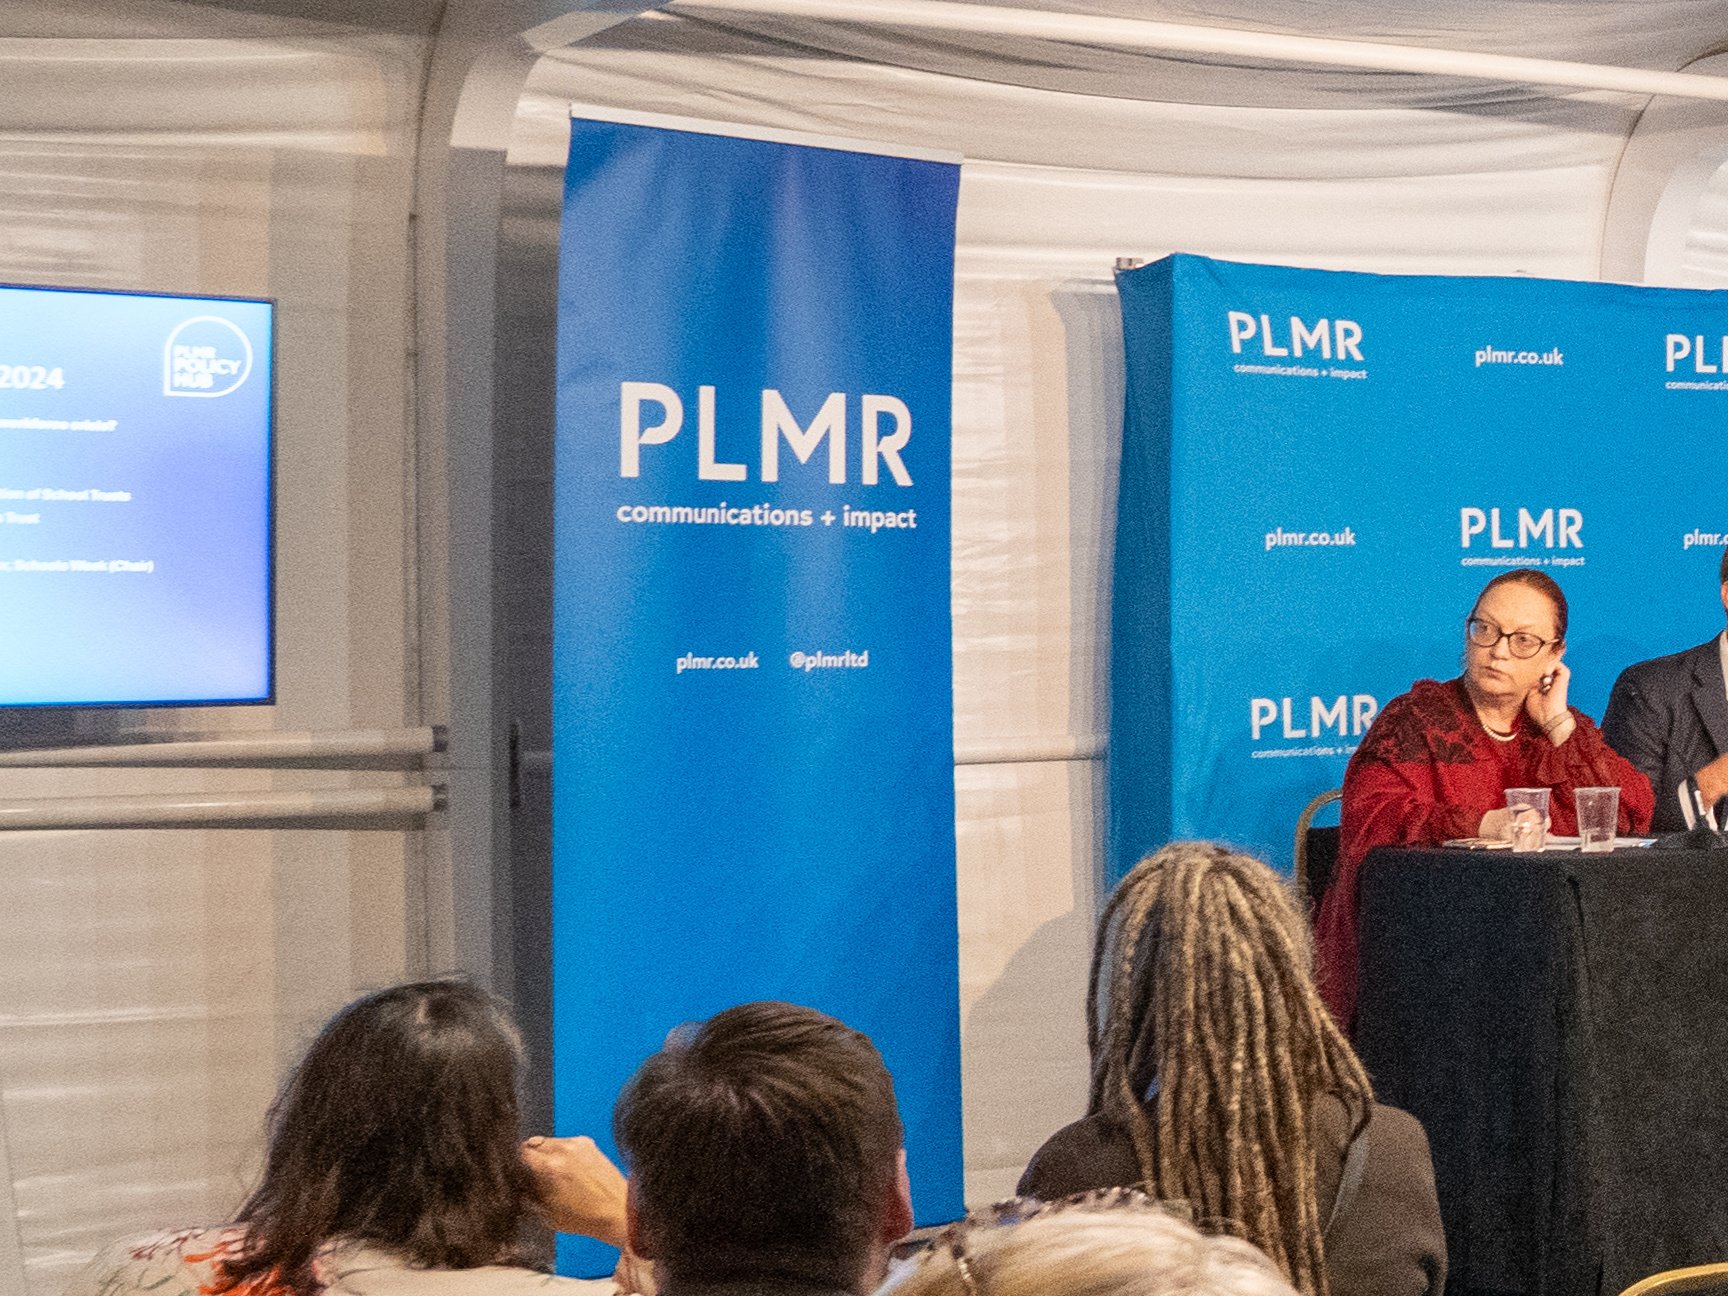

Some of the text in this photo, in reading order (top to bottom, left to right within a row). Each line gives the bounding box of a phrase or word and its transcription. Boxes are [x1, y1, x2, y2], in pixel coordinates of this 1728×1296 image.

[1228, 311, 1363, 361] PLMR
[174, 359, 241, 375] POLICY
[1475, 345, 1563, 367] plmr.co.uk
[0, 364, 66, 390] 2024
[174, 373, 214, 389] HUB
[1234, 364, 1320, 377] communications
[1329, 367, 1367, 380] impact
[620, 380, 913, 487] PLMR
[616, 502, 916, 533] communications + impact
[1461, 507, 1583, 548] PLMR
[1265, 527, 1355, 551] plmr.co.uk
[1461, 557, 1542, 566] communications
[1550, 557, 1584, 567] impact
[677, 650, 868, 673] plmr.co.uk @plmrltd
[1251, 694, 1378, 739] PLMR
[1252, 747, 1334, 759] communications
